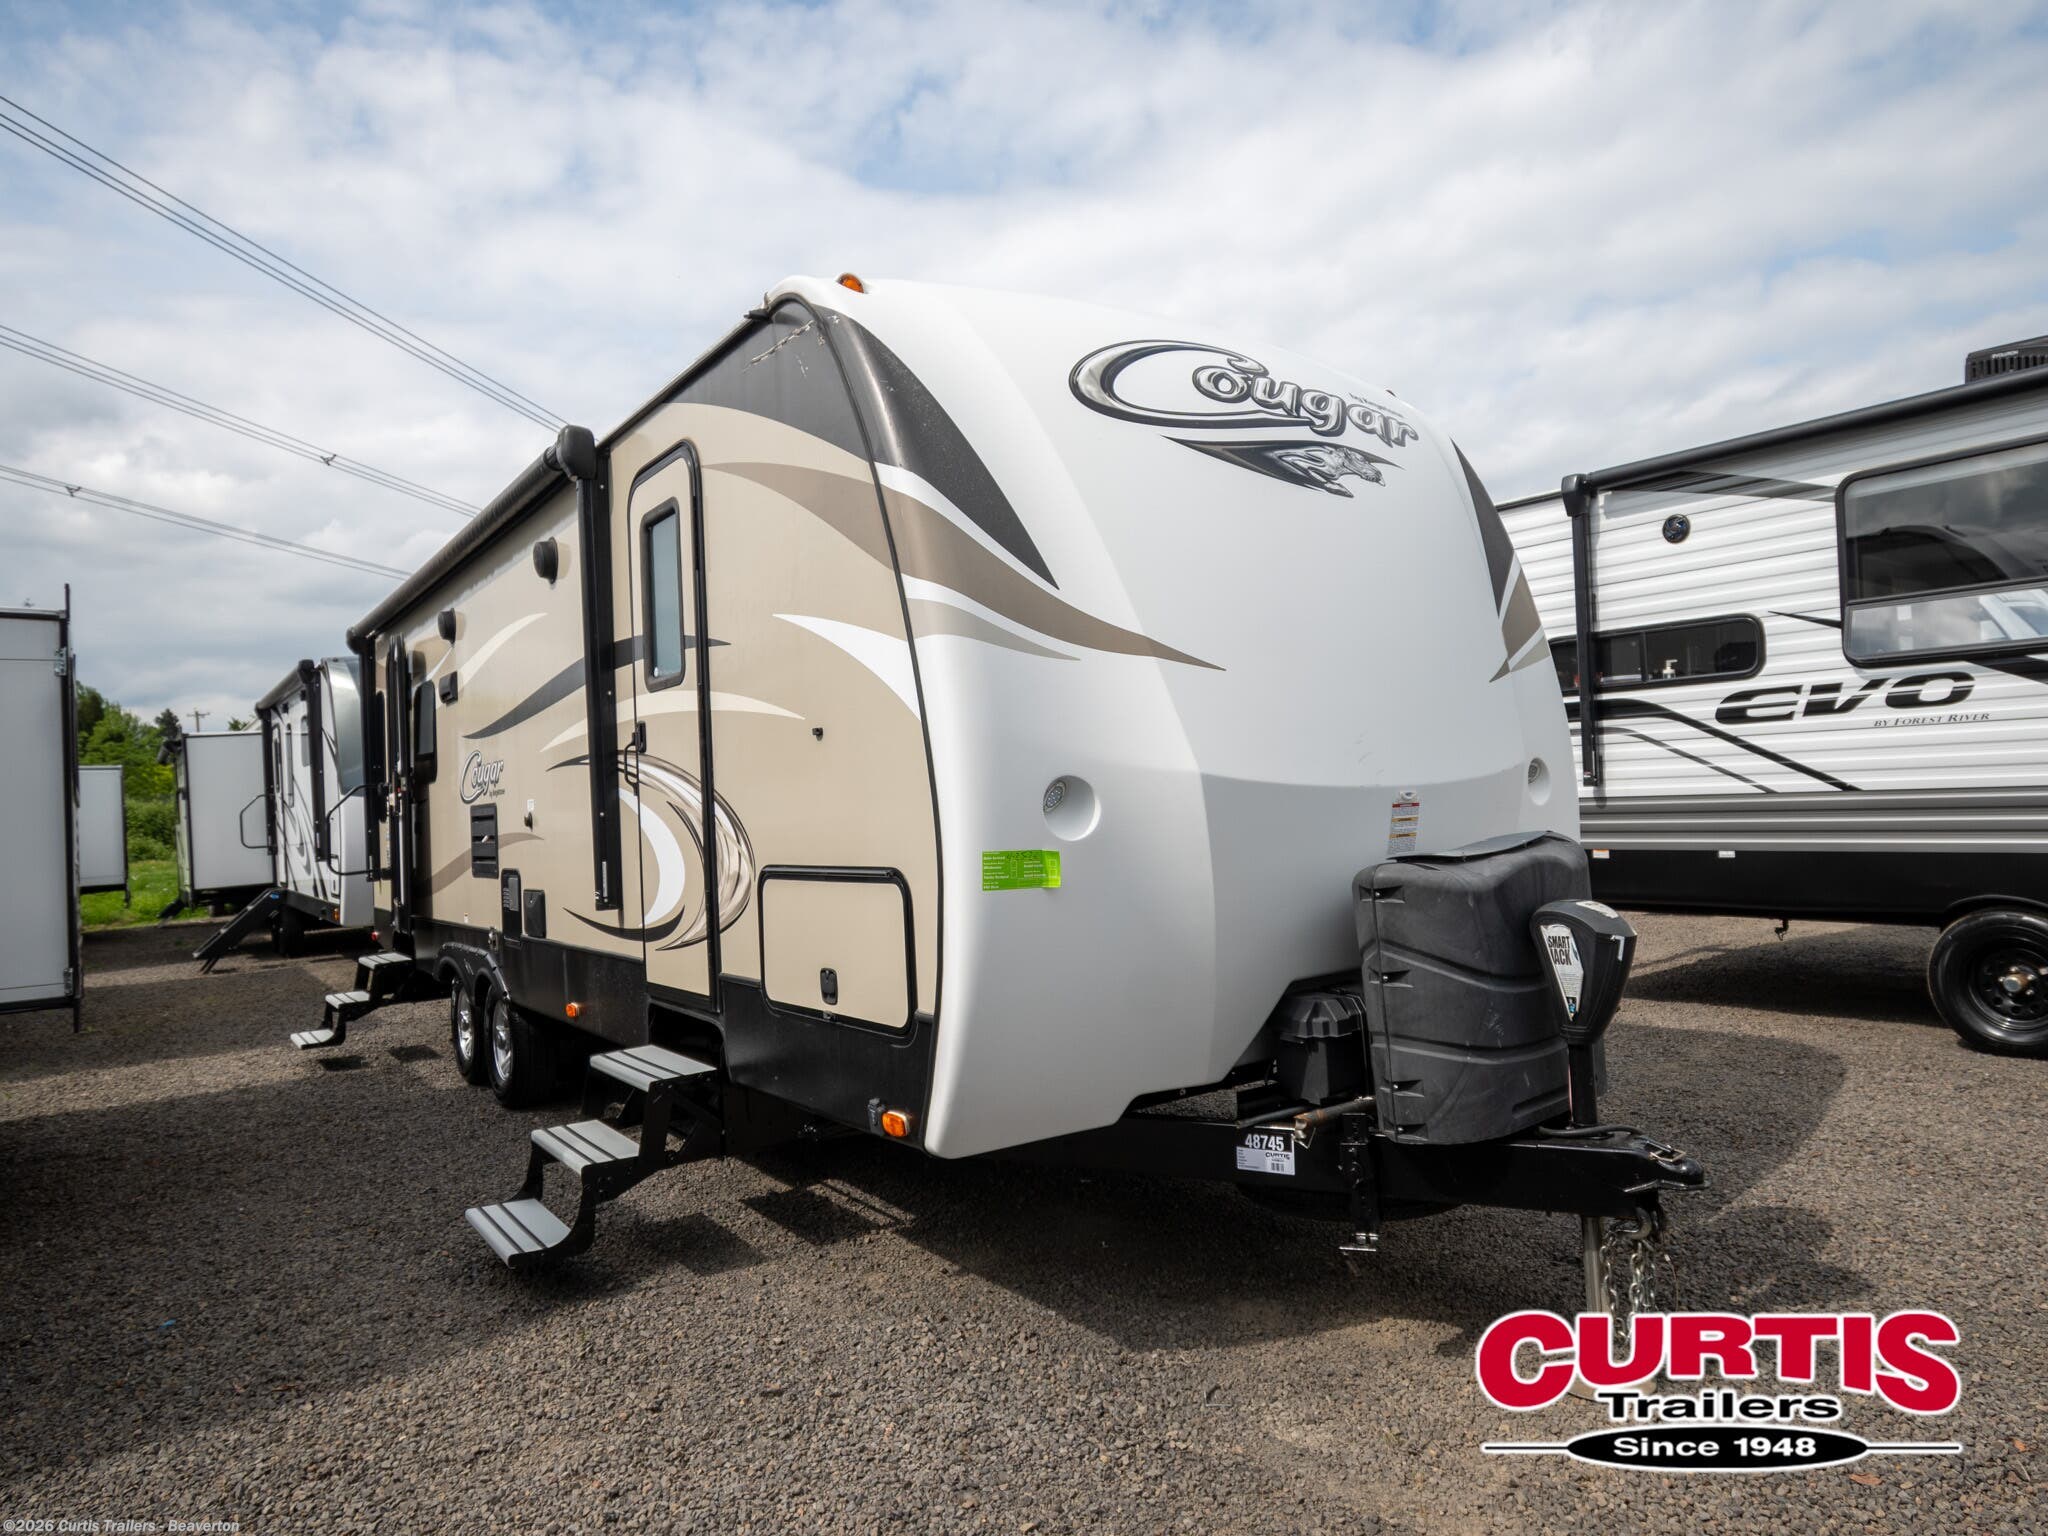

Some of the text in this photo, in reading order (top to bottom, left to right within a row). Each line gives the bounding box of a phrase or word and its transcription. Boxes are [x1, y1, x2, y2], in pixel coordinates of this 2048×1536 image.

[1068, 339, 1419, 448] Cougar
[1894, 716, 1943, 726] FOREST
[1948, 713, 1991, 722] RIVER
[460, 750, 504, 804] Cougar
[1548, 936, 1570, 948] SMART
[1245, 1134, 1284, 1151] 48745
[1265, 1152, 1290, 1160] CURTIS
